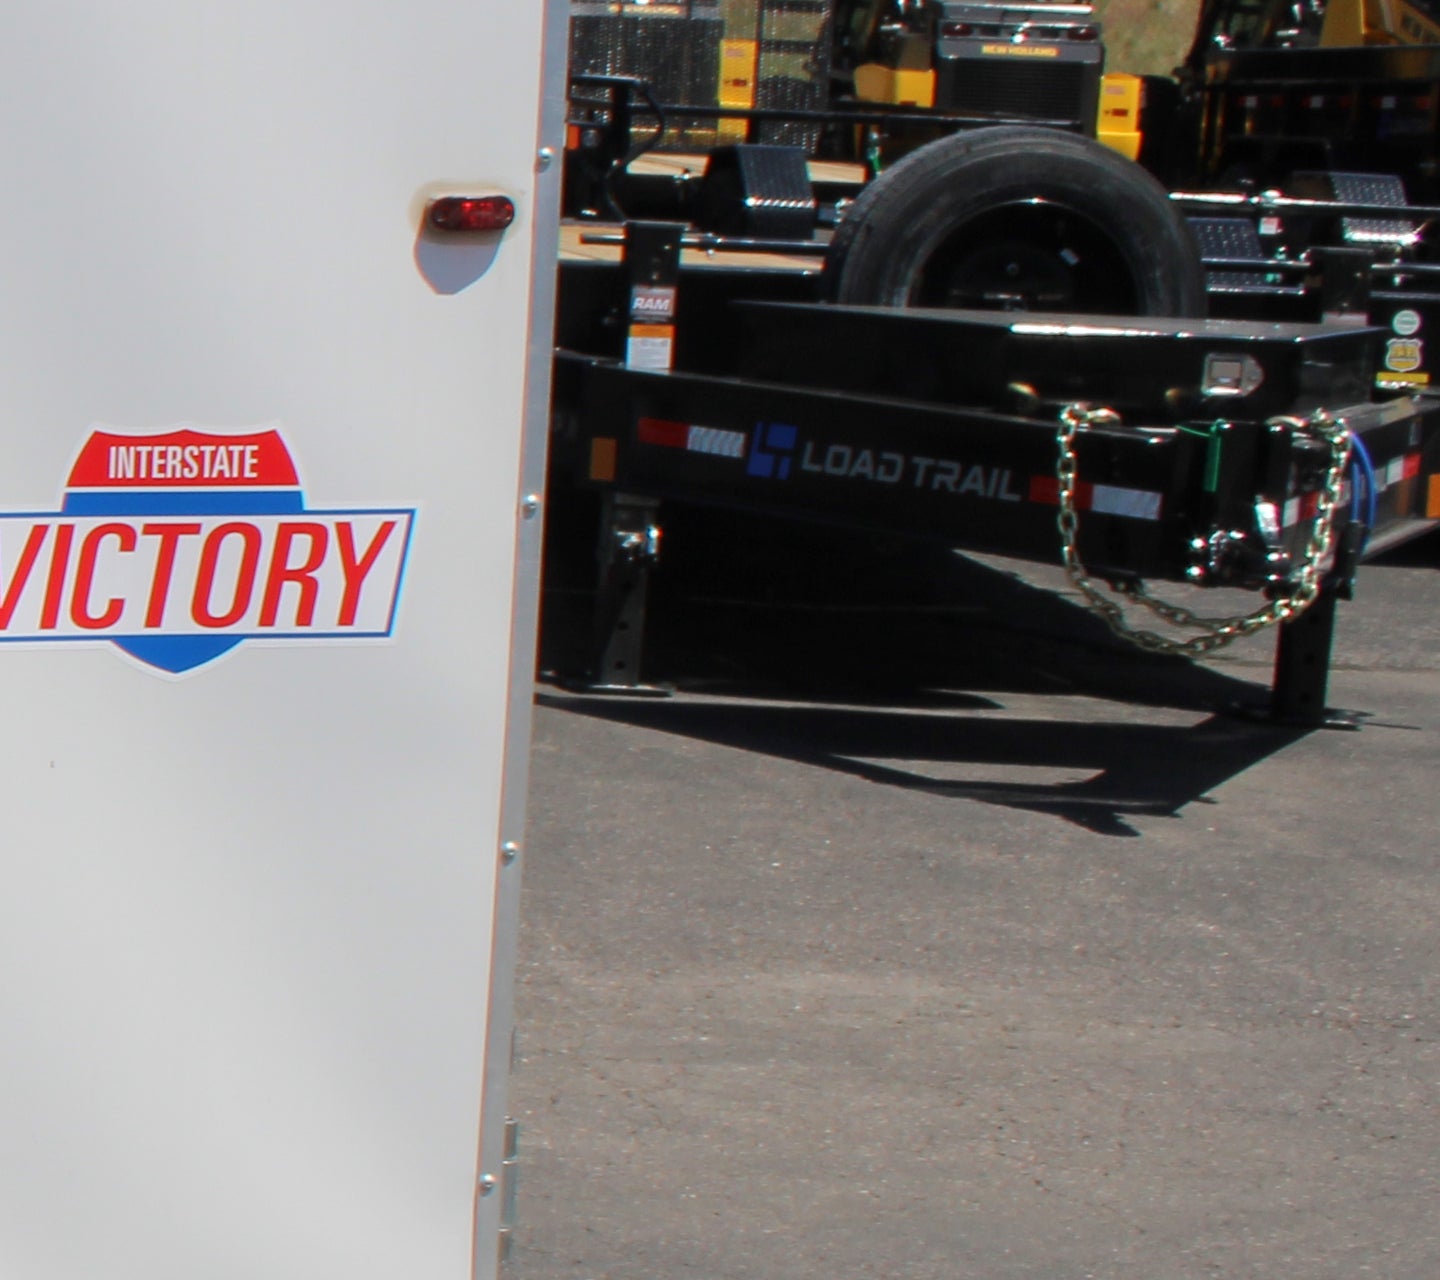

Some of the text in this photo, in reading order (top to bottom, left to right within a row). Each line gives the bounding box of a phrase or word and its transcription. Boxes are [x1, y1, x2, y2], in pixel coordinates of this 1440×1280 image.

[632, 297, 669, 310] RAM
[108, 445, 259, 479] INTERSTATE
[801, 432, 1021, 502] LOAD TRAIL
